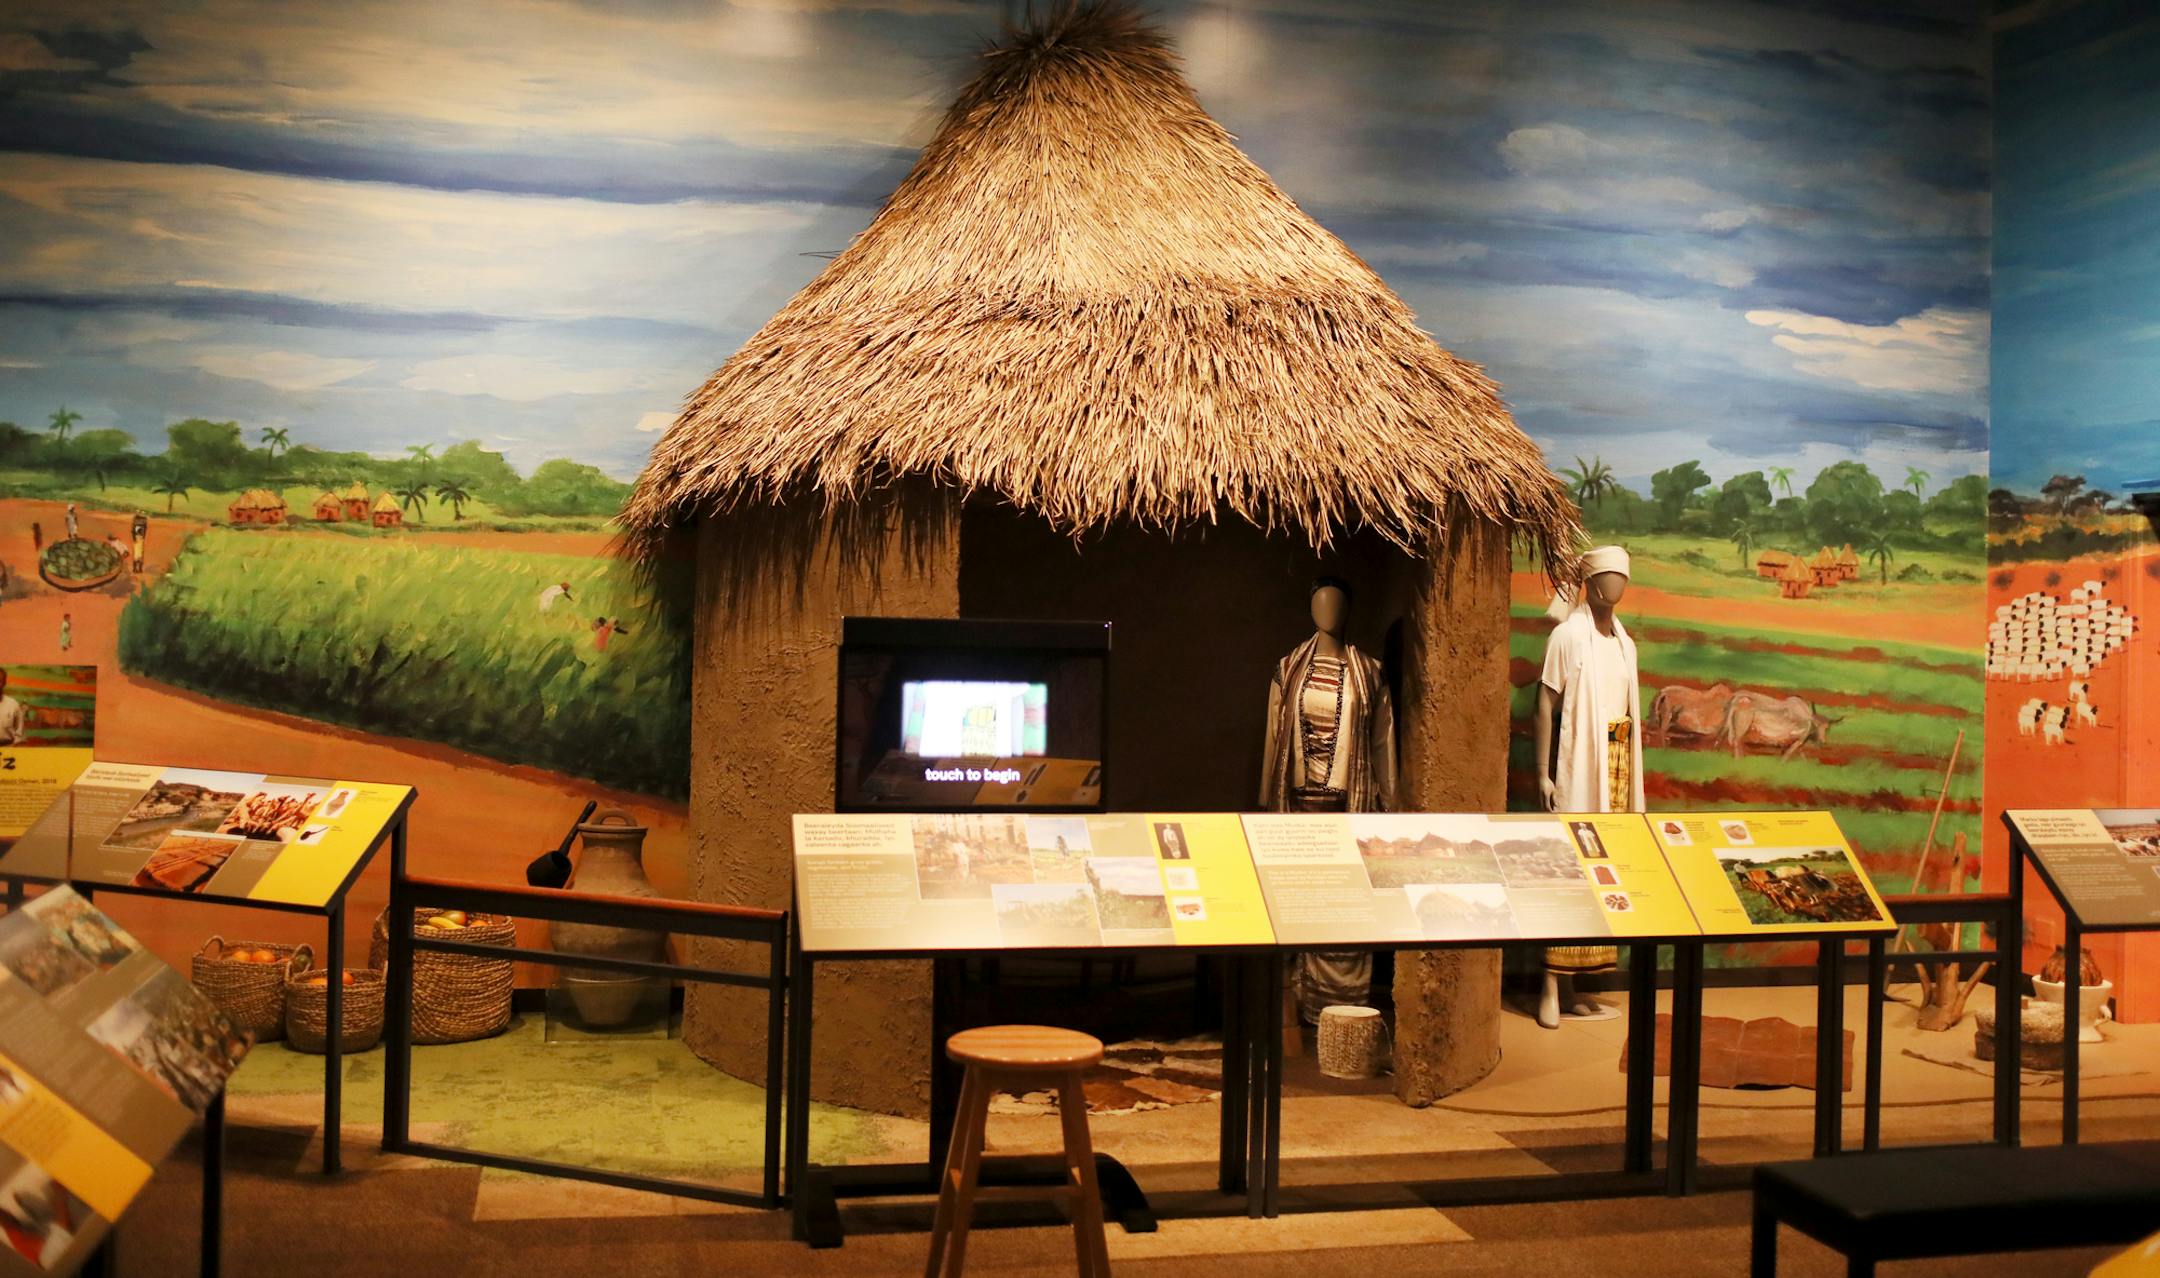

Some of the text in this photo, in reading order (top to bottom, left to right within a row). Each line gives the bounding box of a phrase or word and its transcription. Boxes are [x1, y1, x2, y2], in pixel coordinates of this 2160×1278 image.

[925, 768, 1020, 784] touch to begin
